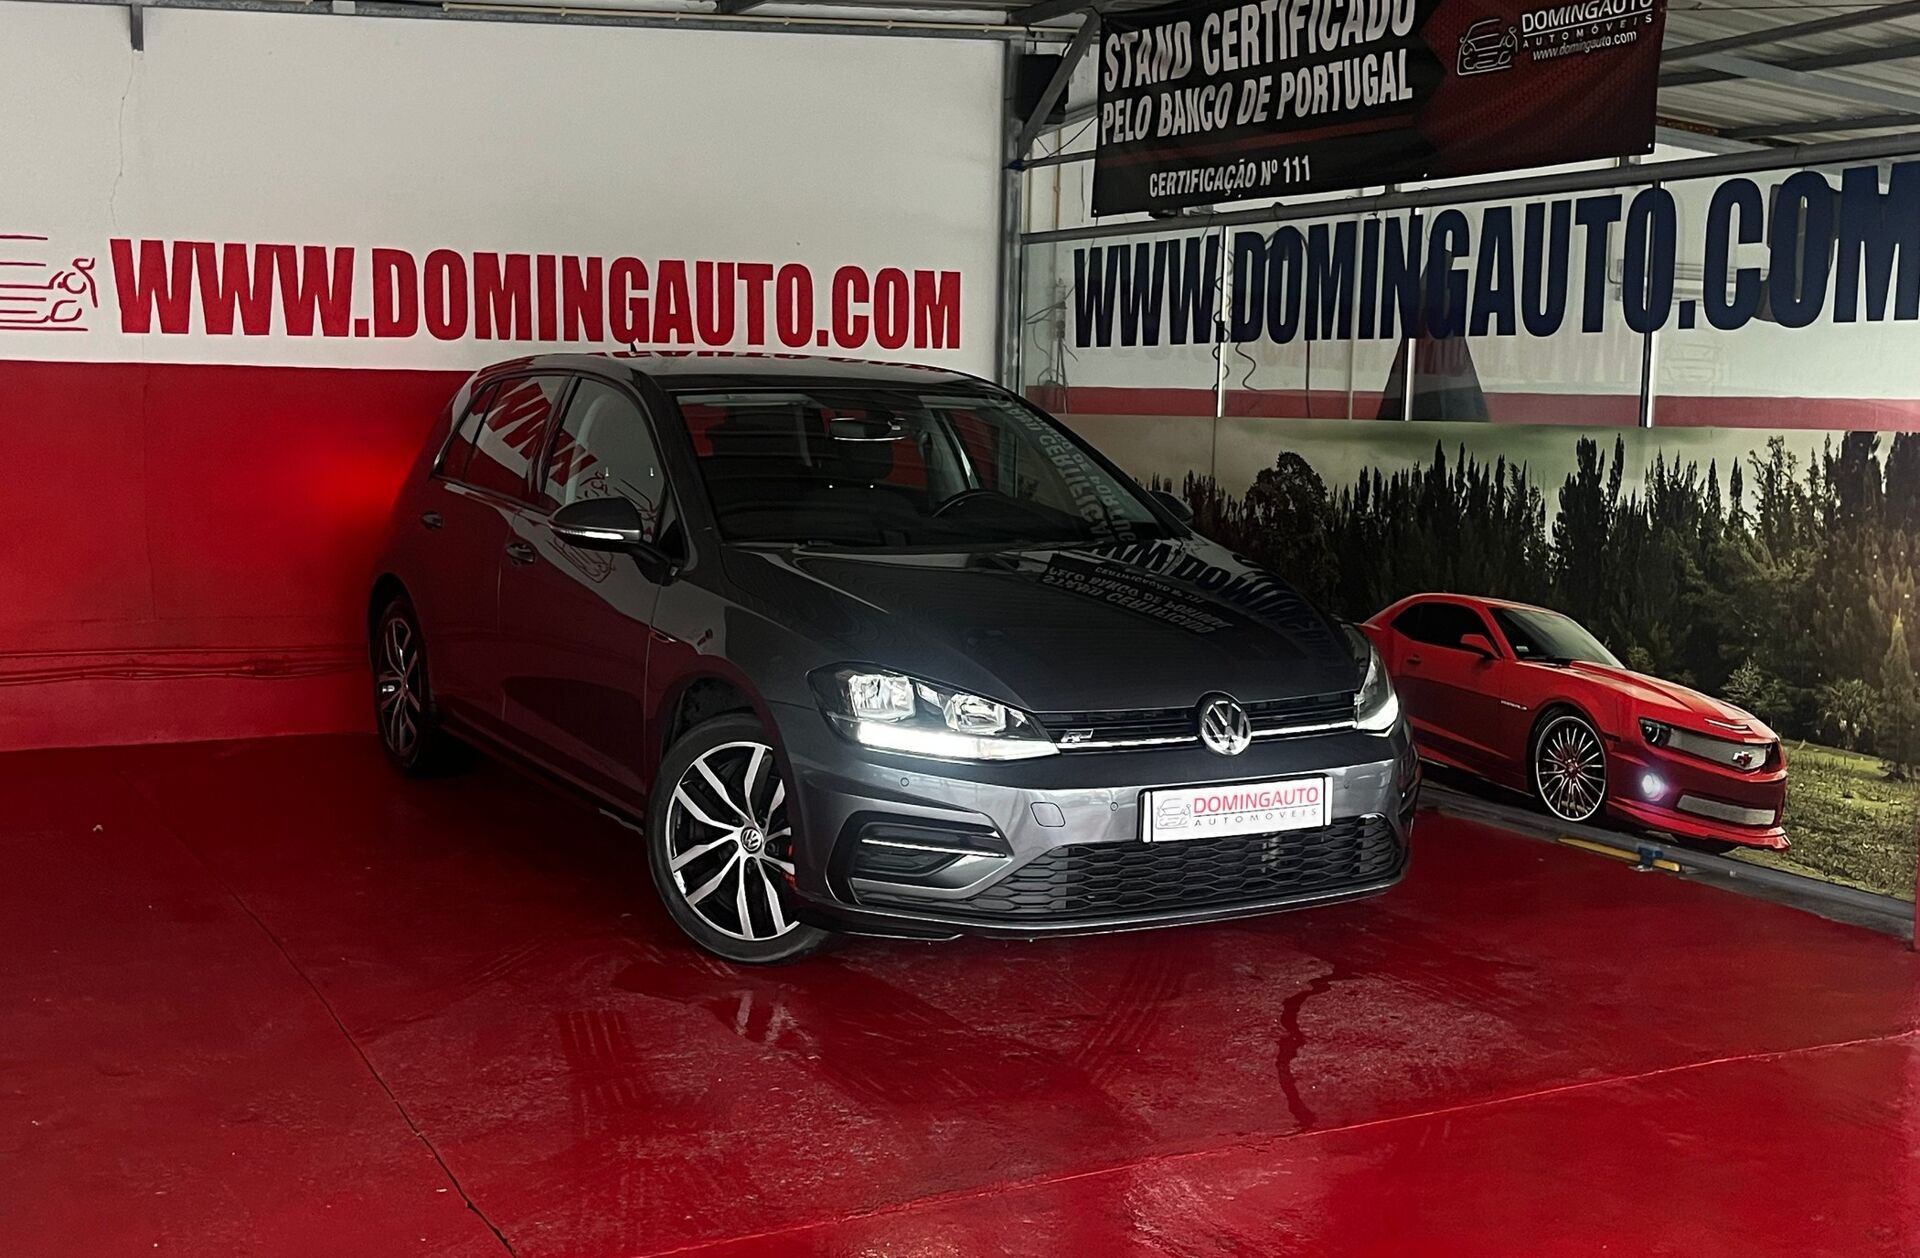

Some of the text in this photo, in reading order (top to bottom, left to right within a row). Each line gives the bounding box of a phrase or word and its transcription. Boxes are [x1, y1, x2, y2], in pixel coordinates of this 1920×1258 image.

[1104, 0, 1416, 93] STAND CERTIFICADO
[1532, 30, 1637, 61] www.domingauto.com
[1101, 48, 1413, 146] PELO BANCO DE PORTUGAL
[1149, 158, 1257, 198] CERTIFICAÇÃO
[1283, 155, 1311, 183] 111
[110, 239, 961, 349] WWW.DOMINGAUTO.COM
[1074, 160, 1920, 348] WWW.DOMINGAUTO.COM
[1194, 787, 1319, 814] DOMINGAUTO
